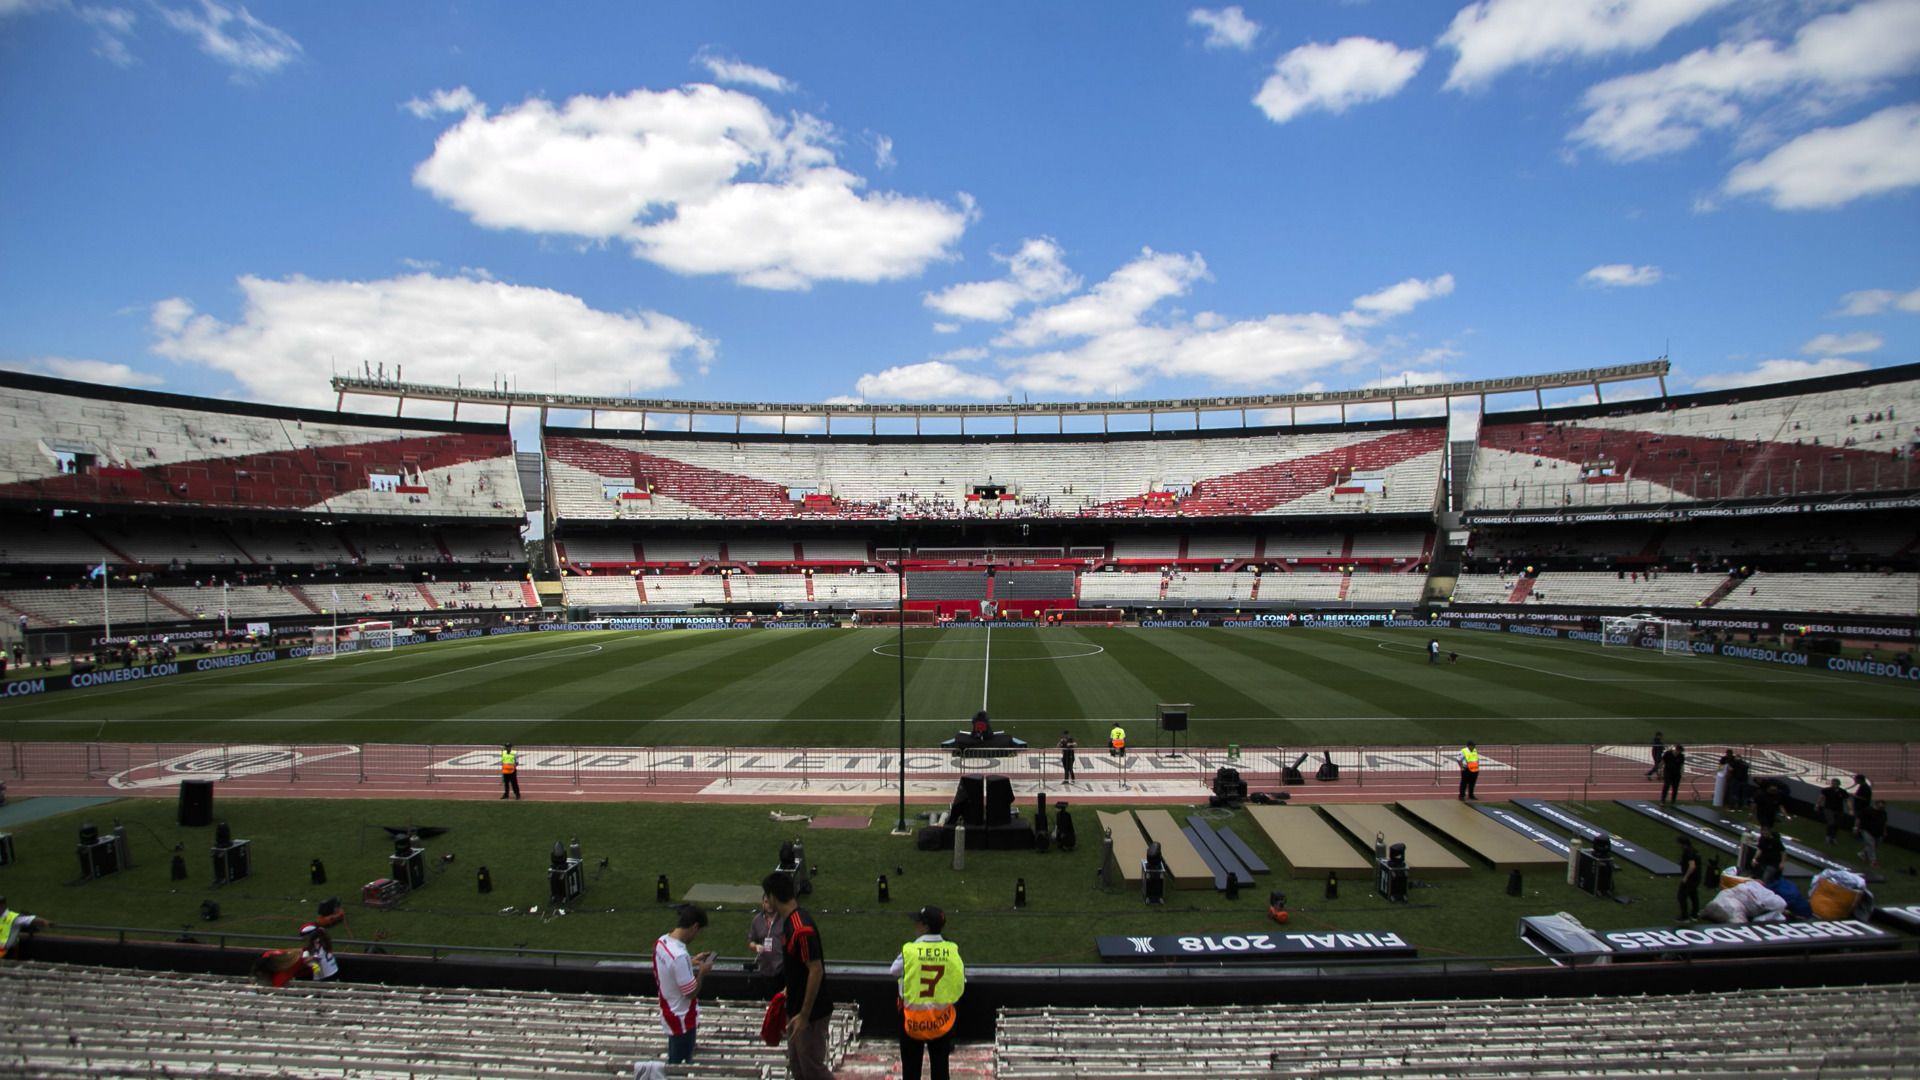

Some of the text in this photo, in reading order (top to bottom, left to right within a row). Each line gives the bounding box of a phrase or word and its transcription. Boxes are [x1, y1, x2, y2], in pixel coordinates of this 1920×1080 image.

[1736, 506, 1799, 515] LIBERTADORES
[1815, 502, 1867, 511] CONMEBOL
[1618, 512, 1673, 520] LIBERTADORES
[539, 622, 602, 631] CONMEBOL.COM
[1384, 619, 1450, 627] CONMEBOL.COM
[1460, 621, 1501, 631] CONMEBOL.COM
[436, 629, 482, 641] CONMEBOL.COM
[490, 625, 529, 636] CONMEBOL.COM
[1510, 624, 1558, 637] CONMEBOL.COM
[1837, 626, 1910, 636] LIBERTADORES
[197, 651, 275, 670] CONMEBOL.COM
[1722, 645, 1807, 665] CONMEBOL.COM
[72, 663, 178, 687] CONMEBOL.COM
[646, 756, 1001, 769] ATLETICO
[1606, 920, 1886, 950] LIBERTADORES
[1178, 932, 1407, 954] FINAL 2018
[917, 948, 949, 957] TECH
